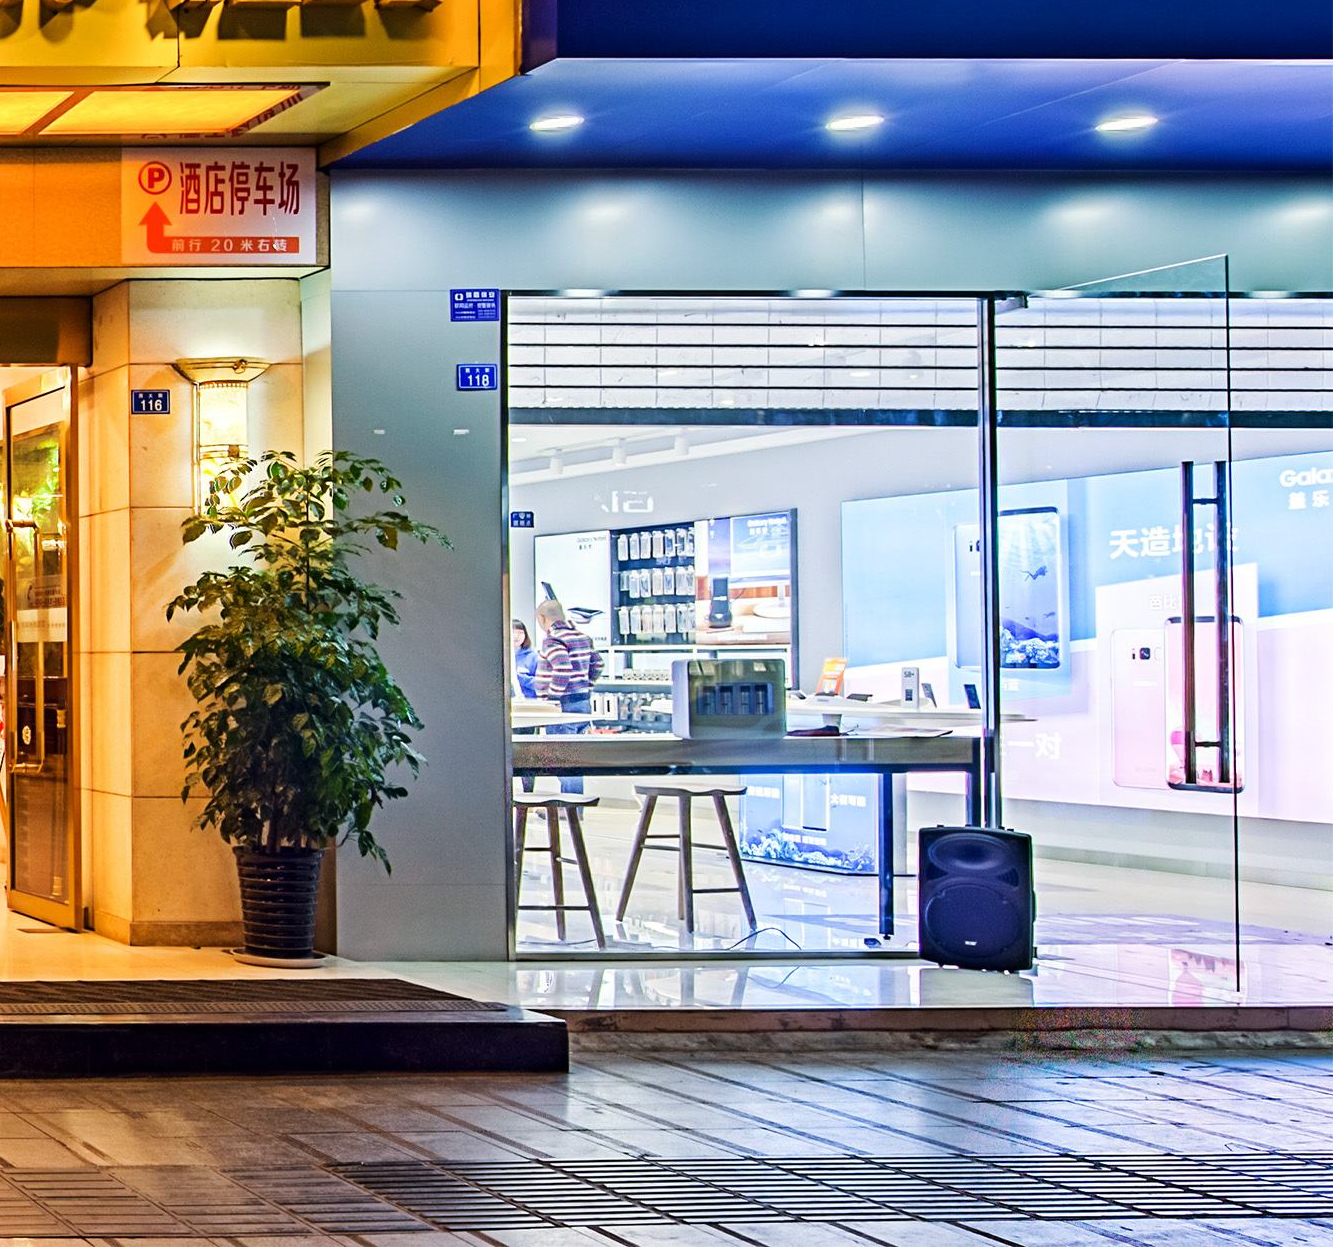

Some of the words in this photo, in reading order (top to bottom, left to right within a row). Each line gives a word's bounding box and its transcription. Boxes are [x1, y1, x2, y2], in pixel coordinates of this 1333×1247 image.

[179, 161, 300, 216] 酒店停车场
[468, 374, 490, 386] 118
[140, 399, 163, 411] 116
[1279, 467, 1333, 488] Gala
